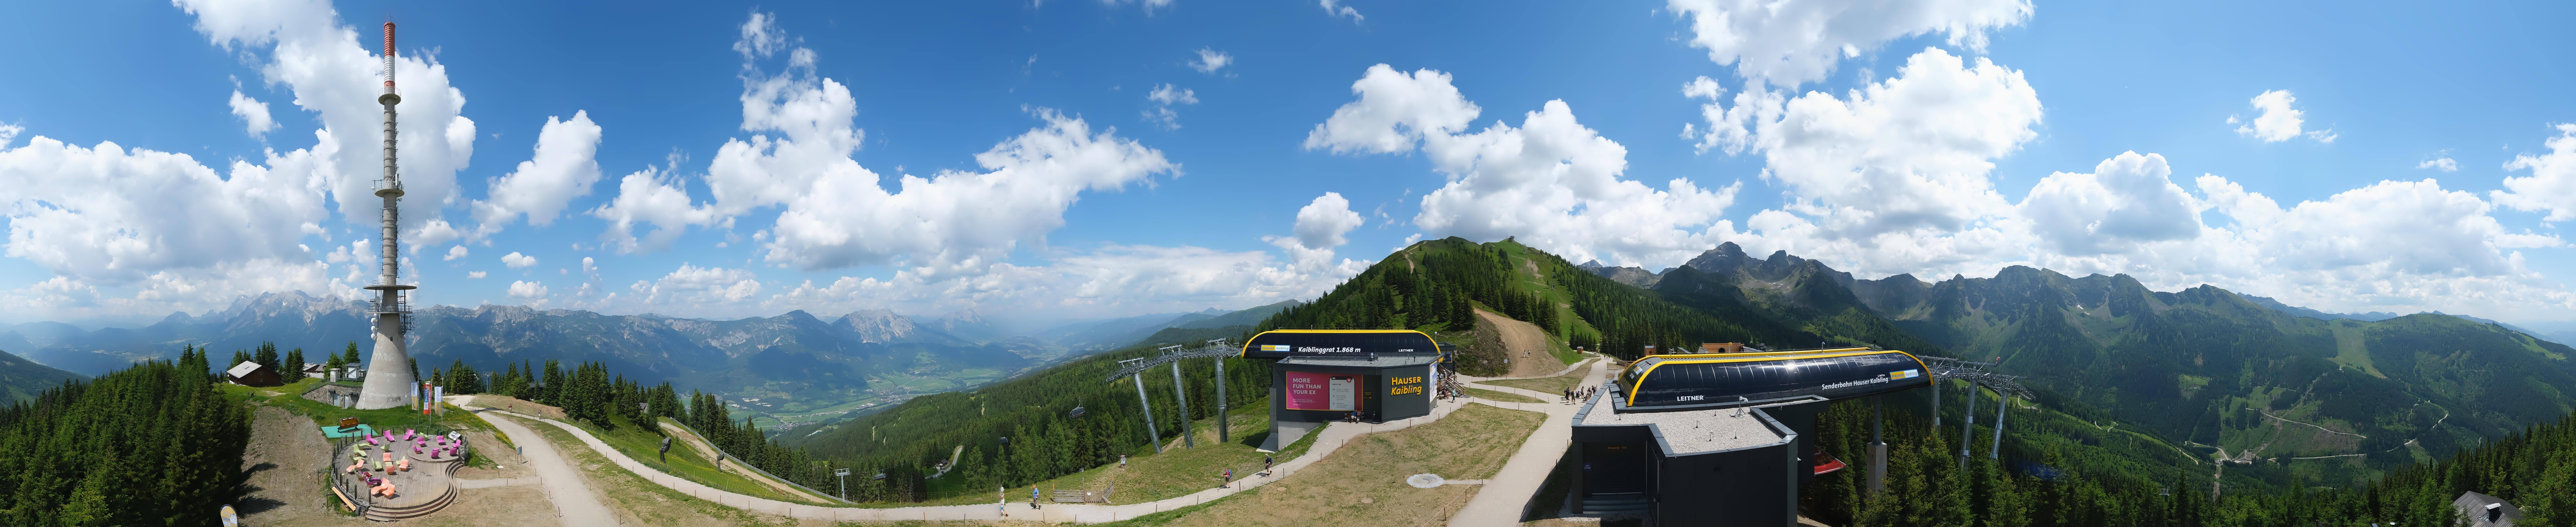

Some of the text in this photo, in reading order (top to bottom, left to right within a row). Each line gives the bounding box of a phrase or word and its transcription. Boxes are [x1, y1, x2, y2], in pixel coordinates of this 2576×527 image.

[1392, 377, 1421, 385] HAUSER
[1822, 381, 1852, 390] Senderbahn
[1391, 385, 1422, 395] Kaibling
